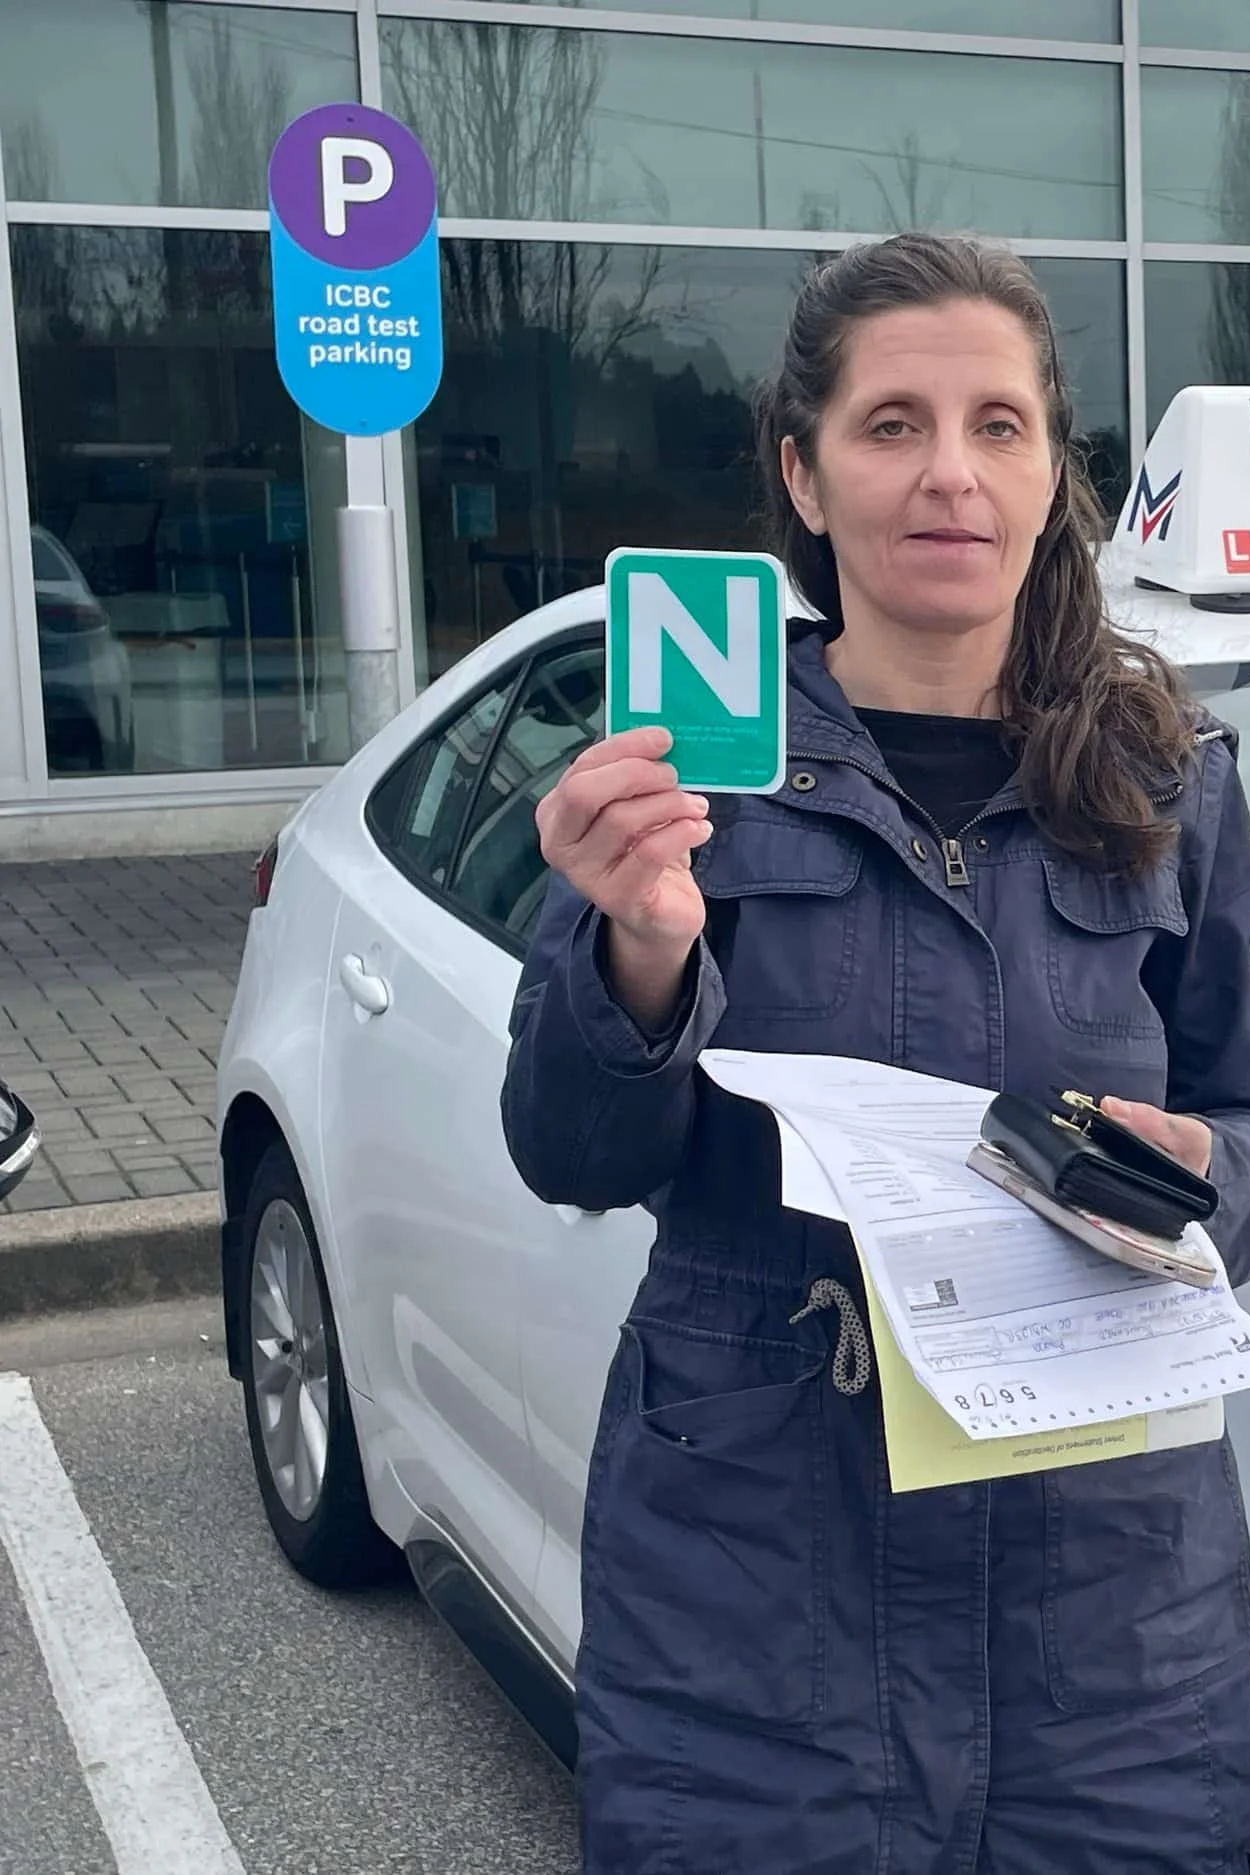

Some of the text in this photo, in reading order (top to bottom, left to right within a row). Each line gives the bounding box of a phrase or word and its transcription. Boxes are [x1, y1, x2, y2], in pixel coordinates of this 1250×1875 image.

[321, 137, 394, 237] P
[326, 284, 391, 308] ICBC
[299, 314, 420, 337] road test
[309, 341, 411, 370] parking
[628, 572, 760, 717] N
[954, 1386, 1036, 1410] 5 6 7 8
